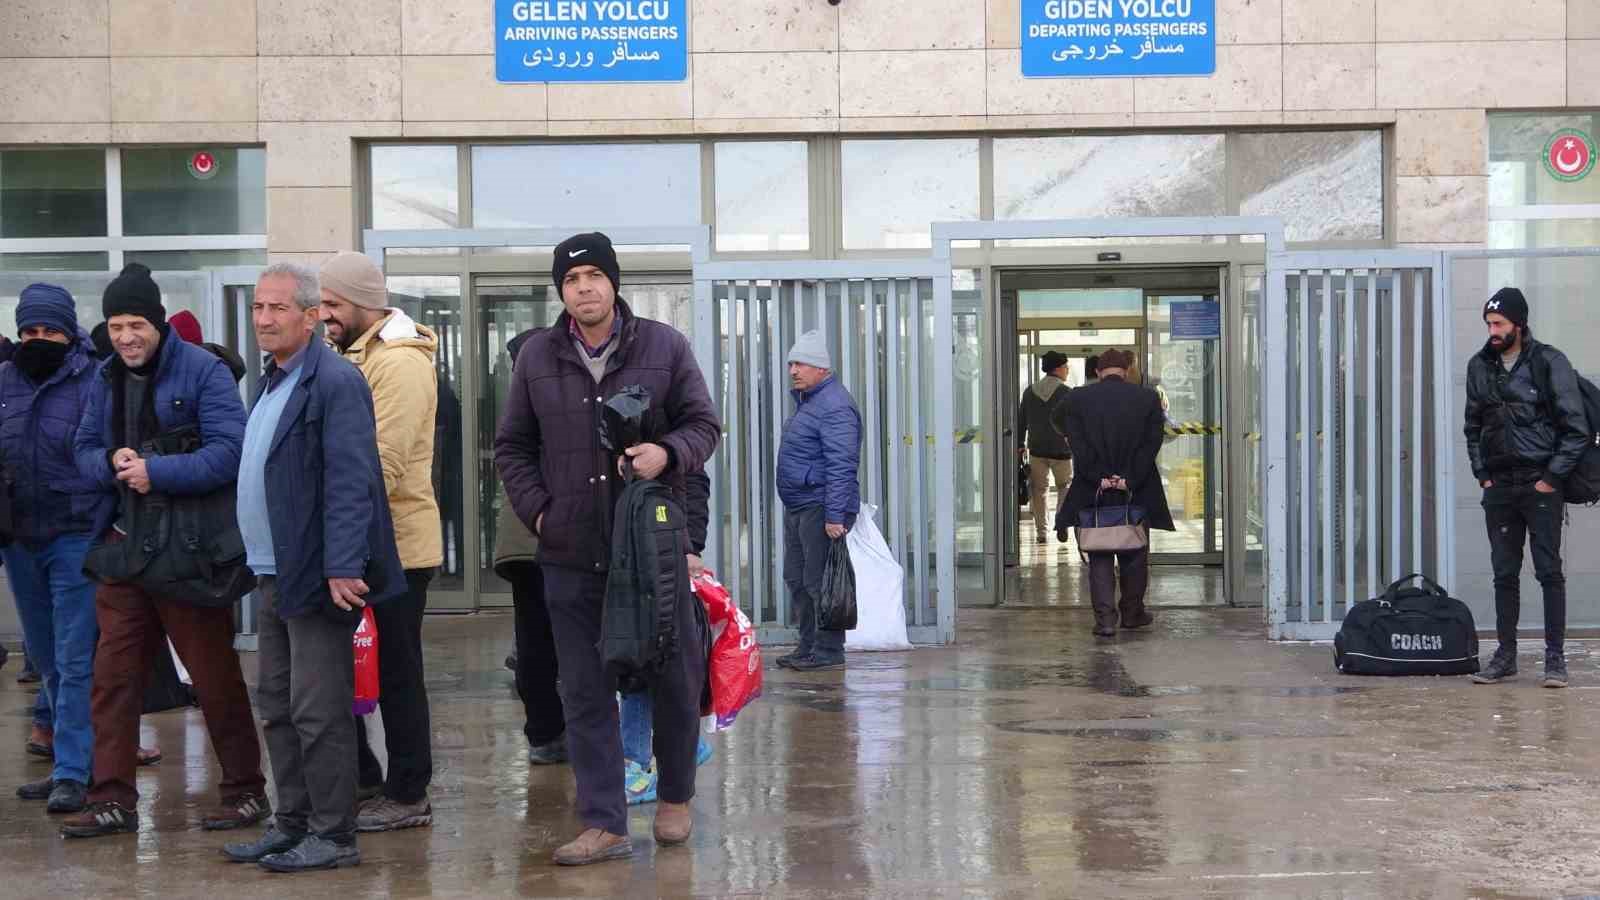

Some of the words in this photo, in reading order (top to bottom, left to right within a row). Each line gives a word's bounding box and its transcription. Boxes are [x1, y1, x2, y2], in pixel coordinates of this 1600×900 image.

[512, 1, 586, 21] GELEN
[594, 0, 669, 21] YOLCU
[1119, 0, 1192, 19] YOLCU
[504, 27, 577, 41] ARRIVING
[581, 27, 678, 40] PASSENGERS
[1029, 24, 1111, 38] DEPARTING
[1114, 22, 1207, 36] PASSENGERS
[602, 42, 660, 68] مسافر
[1130, 36, 1186, 60] مسافر
[1391, 633, 1442, 650] COACH
